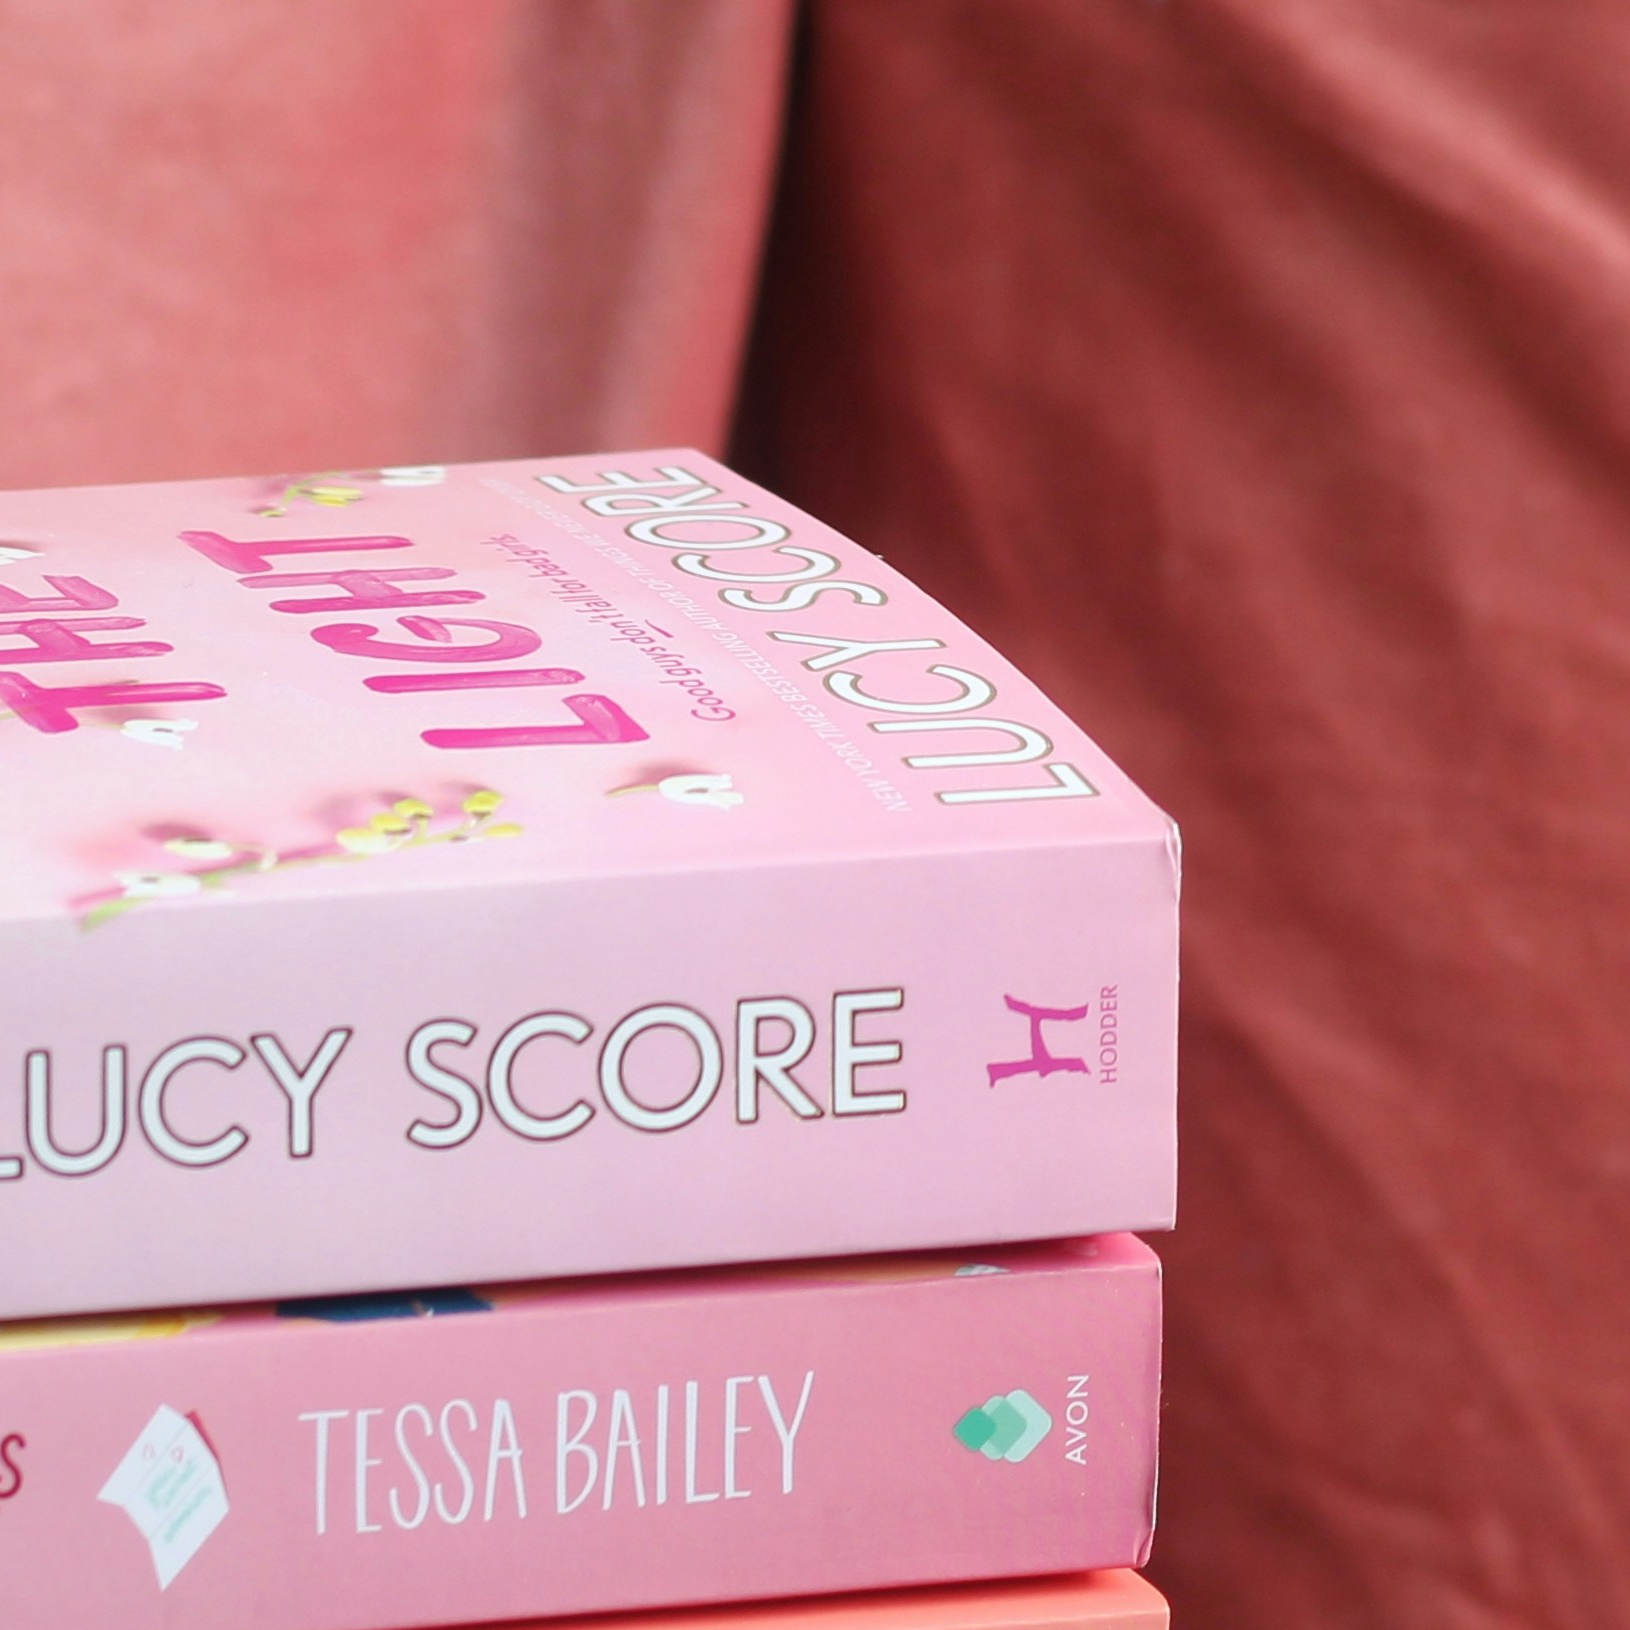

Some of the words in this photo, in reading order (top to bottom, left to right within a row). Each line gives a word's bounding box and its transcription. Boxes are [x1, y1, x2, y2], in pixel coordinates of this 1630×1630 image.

[535, 465, 889, 613] SCORE
[506, 556, 569, 578] bad
[550, 577, 592, 596] for
[637, 576, 673, 592] OF
[558, 595, 617, 614] fall
[663, 592, 726, 634] AUTHOR
[179, 529, 650, 750] LIGHT
[640, 645, 702, 679] guys
[711, 631, 807, 703] BESTSELLING
[659, 676, 736, 722] Good
[766, 631, 1101, 806] LUCY
[790, 703, 845, 741] TIMES
[826, 740, 880, 777] YORK
[865, 776, 913, 813] NEW
[1099, 984, 1118, 1084] HODDER
[403, 985, 908, 1152] SCORE
[1065, 1374, 1089, 1466] AVON
[297, 1388, 528, 1535] TESSA
[555, 1369, 816, 1516] BAILEY
